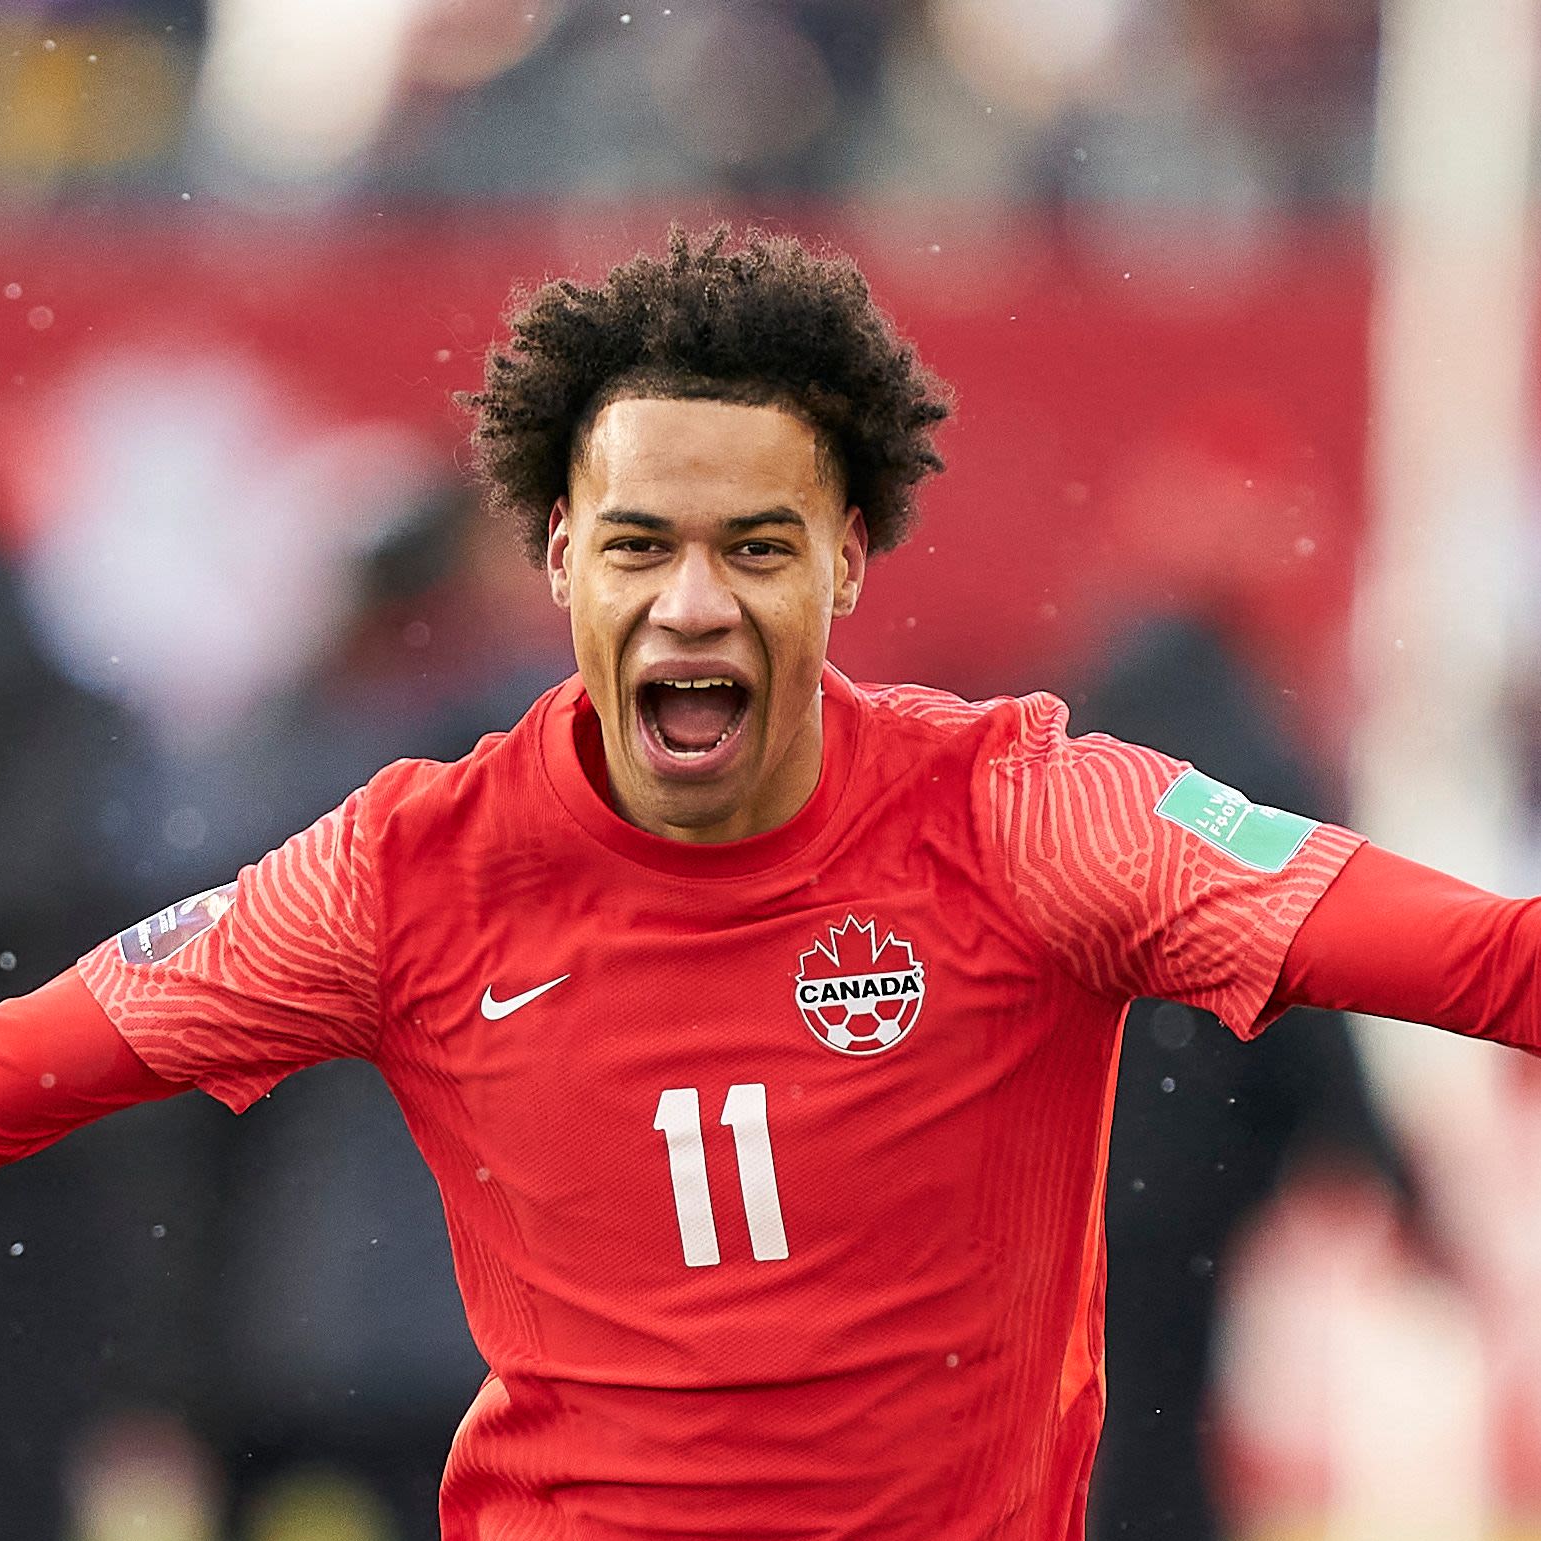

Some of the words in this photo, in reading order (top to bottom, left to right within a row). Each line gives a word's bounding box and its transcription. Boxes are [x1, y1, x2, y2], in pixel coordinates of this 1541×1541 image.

[1195, 788, 1235, 829] LIV
[799, 975, 920, 1004] CANADA
[652, 1083, 790, 1268] 11
